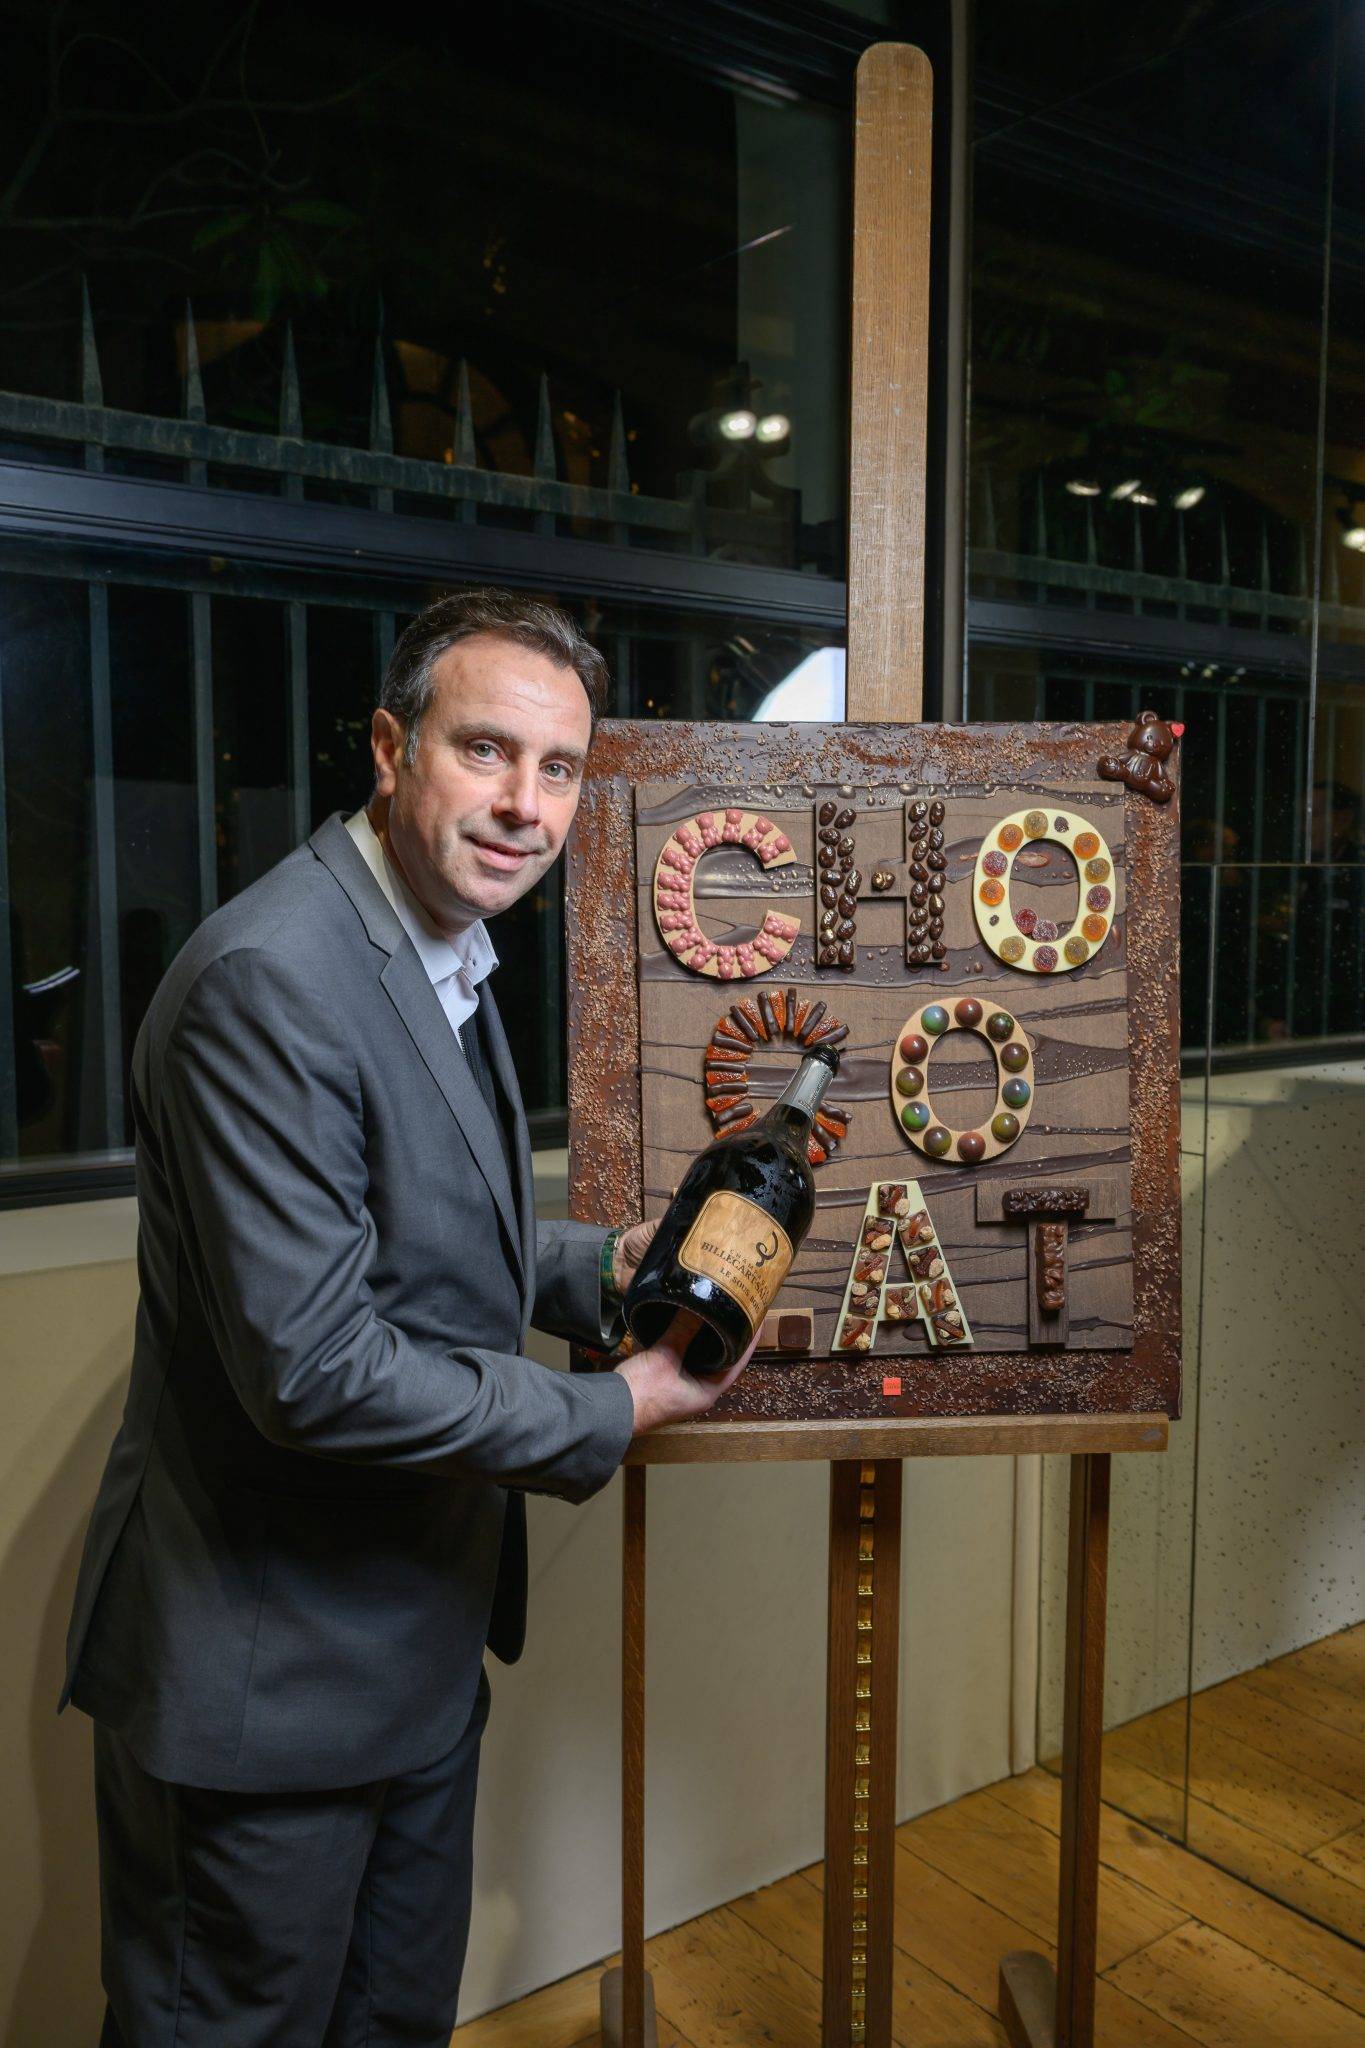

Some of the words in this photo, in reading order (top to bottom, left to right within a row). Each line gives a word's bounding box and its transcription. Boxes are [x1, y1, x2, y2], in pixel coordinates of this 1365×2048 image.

[654, 798, 1116, 979] CHO
[720, 1267, 732, 1279] LE
[732, 1276, 750, 1297] SOUS
